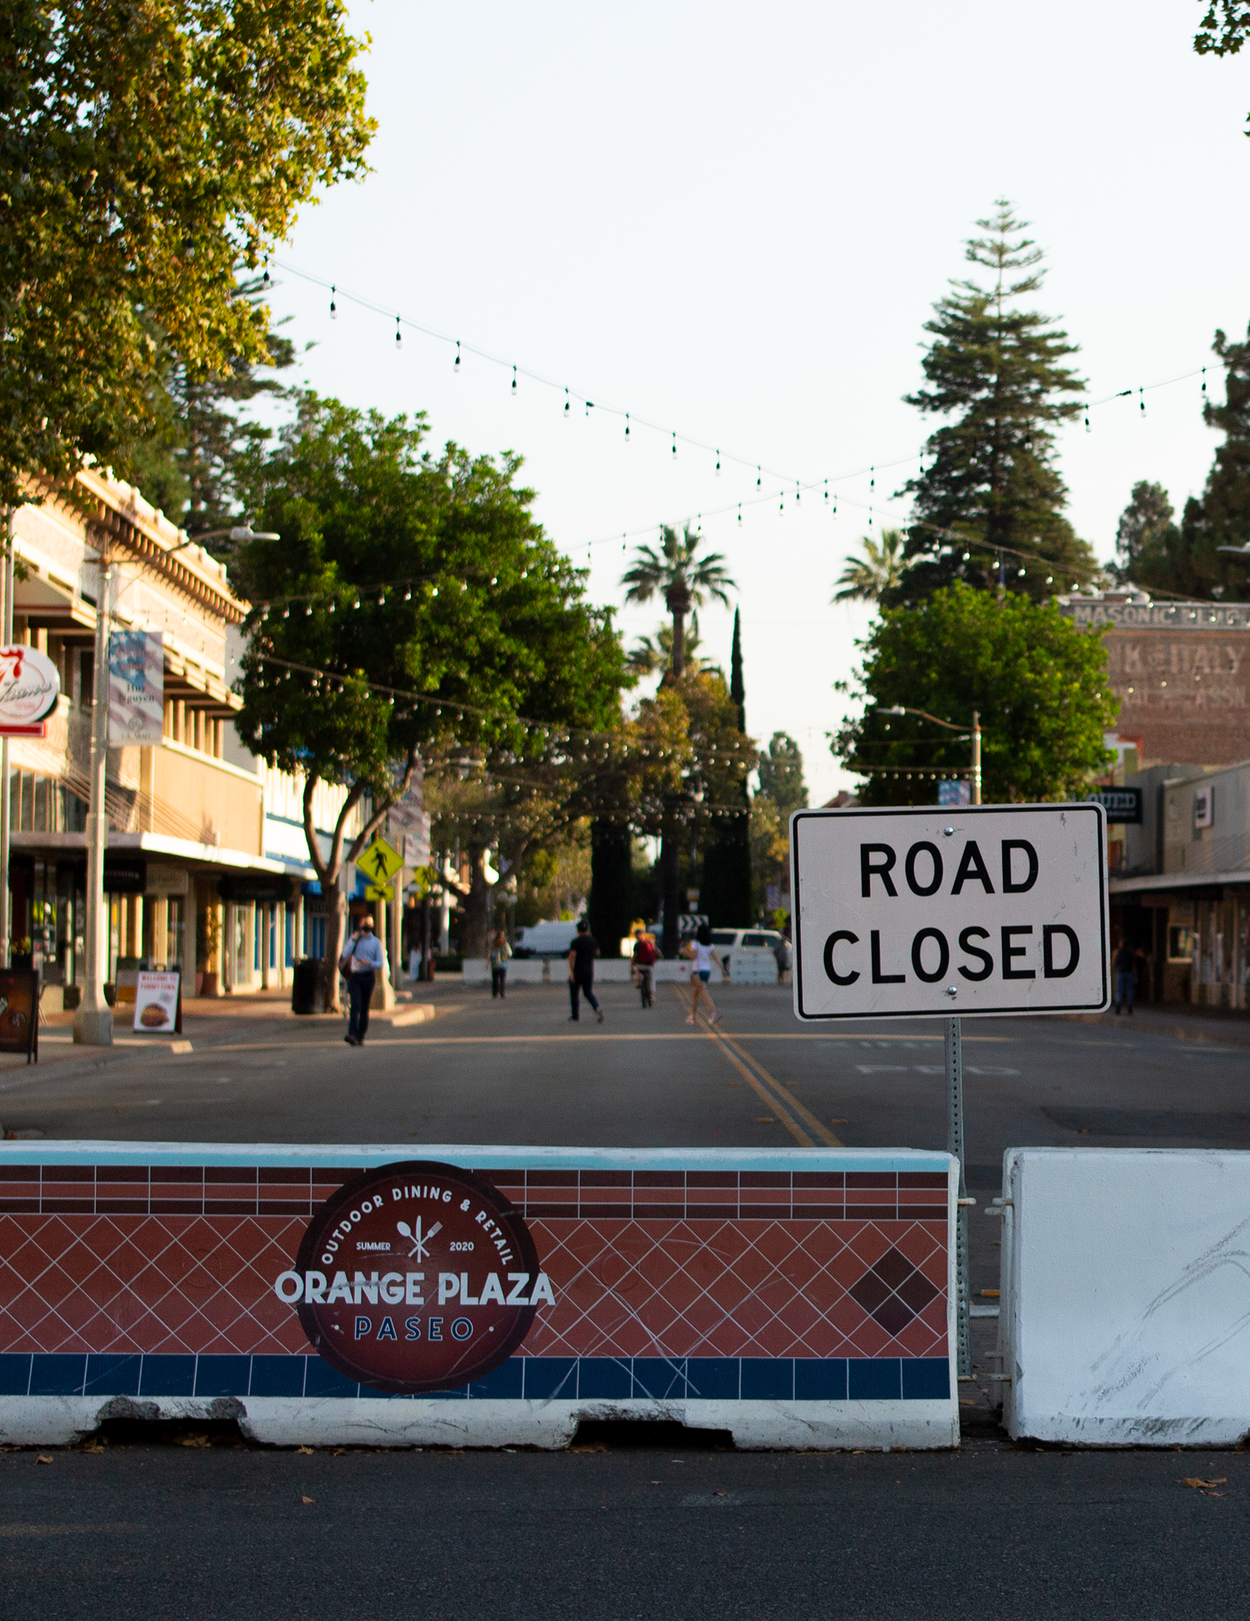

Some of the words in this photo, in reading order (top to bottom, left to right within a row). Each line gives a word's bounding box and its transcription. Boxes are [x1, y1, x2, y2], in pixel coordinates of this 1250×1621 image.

[1074, 606, 1173, 625] MASONIC
[1169, 644, 1246, 675] ITALY
[861, 838, 1039, 899] ROAD
[822, 923, 1080, 986] CLOSED
[321, 1193, 384, 1265] OUTDOOR
[391, 1184, 453, 1203] DINING
[459, 1198, 471, 1212] &
[474, 1210, 514, 1266] RETAIL
[356, 1241, 391, 1251] SUMMER
[450, 1241, 475, 1252] 2020
[274, 1270, 425, 1305] ORANGE
[438, 1271, 556, 1306] PLAZA
[354, 1316, 474, 1341] PASEO
